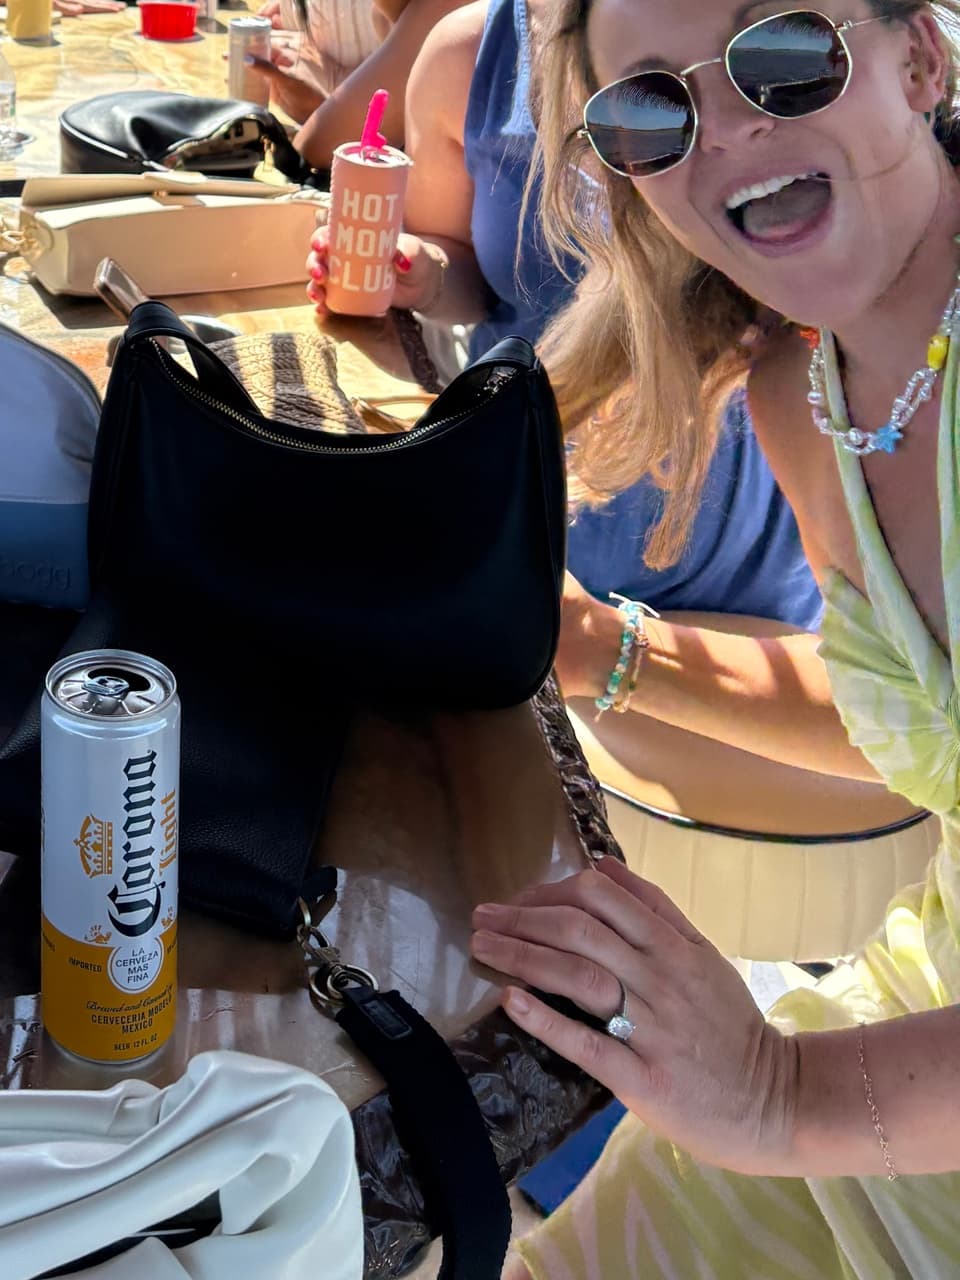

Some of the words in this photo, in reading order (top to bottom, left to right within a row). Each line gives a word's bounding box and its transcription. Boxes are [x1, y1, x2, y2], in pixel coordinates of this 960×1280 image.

[342, 188, 399, 222] HOT
[335, 221, 395, 257] MOM
[329, 254, 397, 293] CLUB
[159, 786, 177, 877] Light
[107, 750, 166, 937] Corona
[115, 950, 159, 969] CERVEZA
[131, 947, 145, 957] LA
[68, 956, 102, 973] IMPORTED
[127, 963, 149, 976] MAS
[127, 972, 149, 984] FINA
[86, 1000, 125, 1013] Brewed
[124, 999, 143, 1011] and
[91, 1012, 146, 1025] CERVECERIA
[121, 1018, 153, 1034] MEXICO
